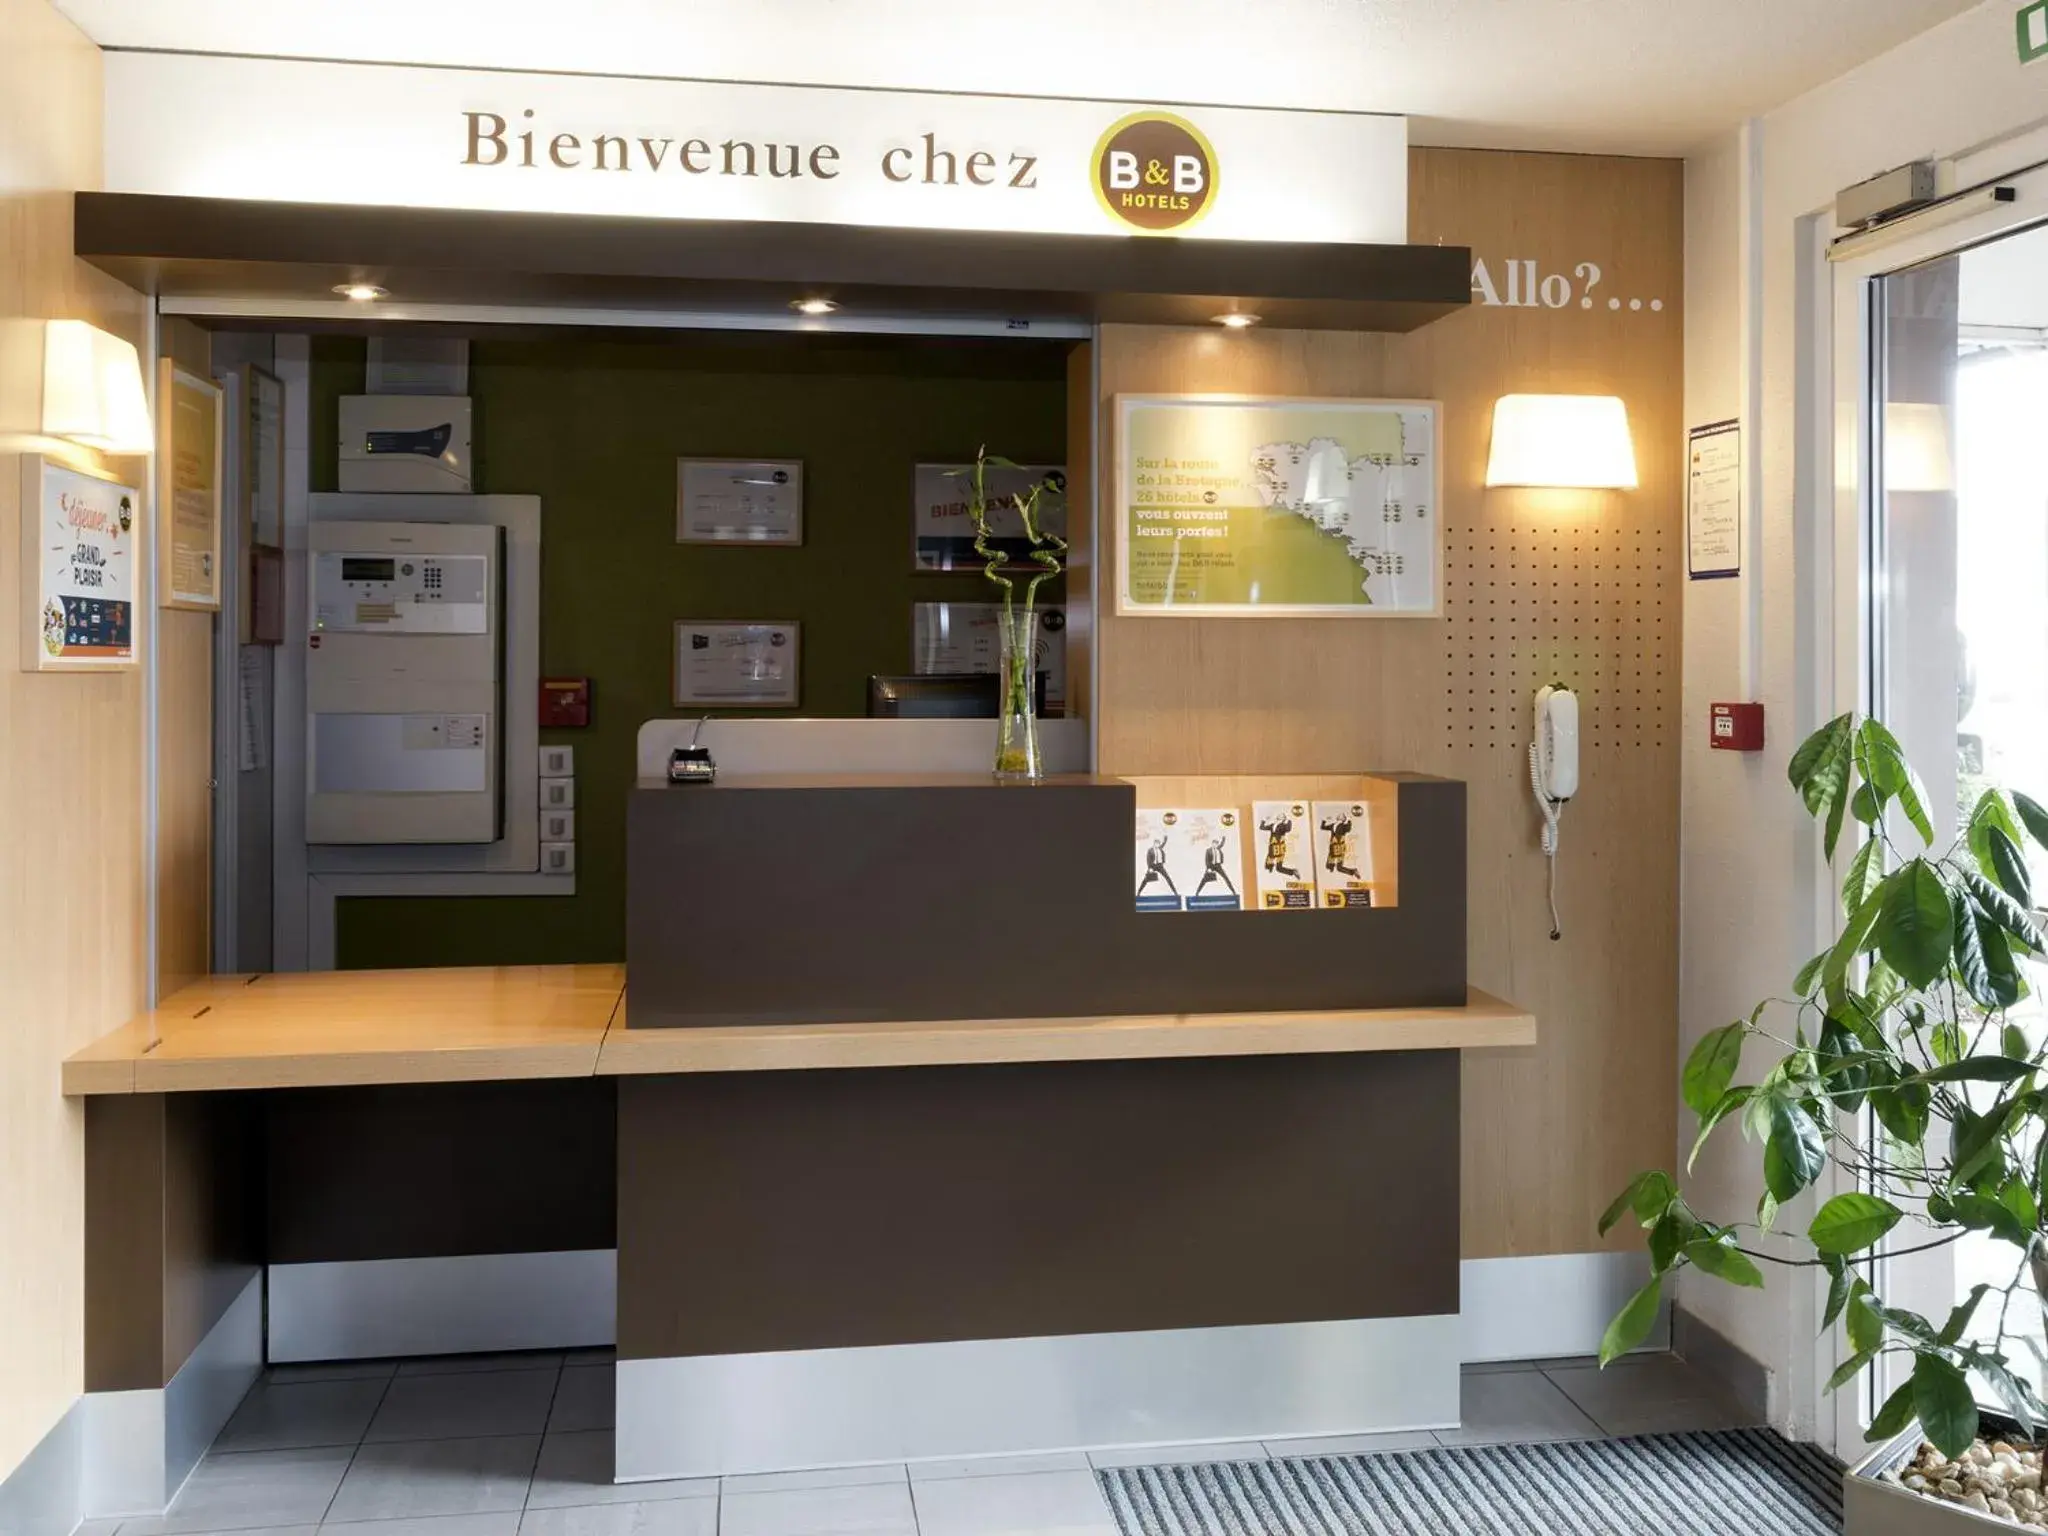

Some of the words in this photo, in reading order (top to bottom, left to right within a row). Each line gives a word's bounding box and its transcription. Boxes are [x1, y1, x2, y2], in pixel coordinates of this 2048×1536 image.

[460, 108, 841, 180] Bienvenue
[881, 132, 1038, 189] chez
[1109, 150, 1204, 194] B&B
[1121, 193, 1190, 210] HOTELS
[1136, 457, 1160, 469] Sur
[1136, 474, 1155, 486] de
[1157, 474, 1172, 486] la
[1136, 510, 1171, 520] vous
[1173, 510, 1229, 520] ouvrent
[1136, 525, 1174, 537] leurs
